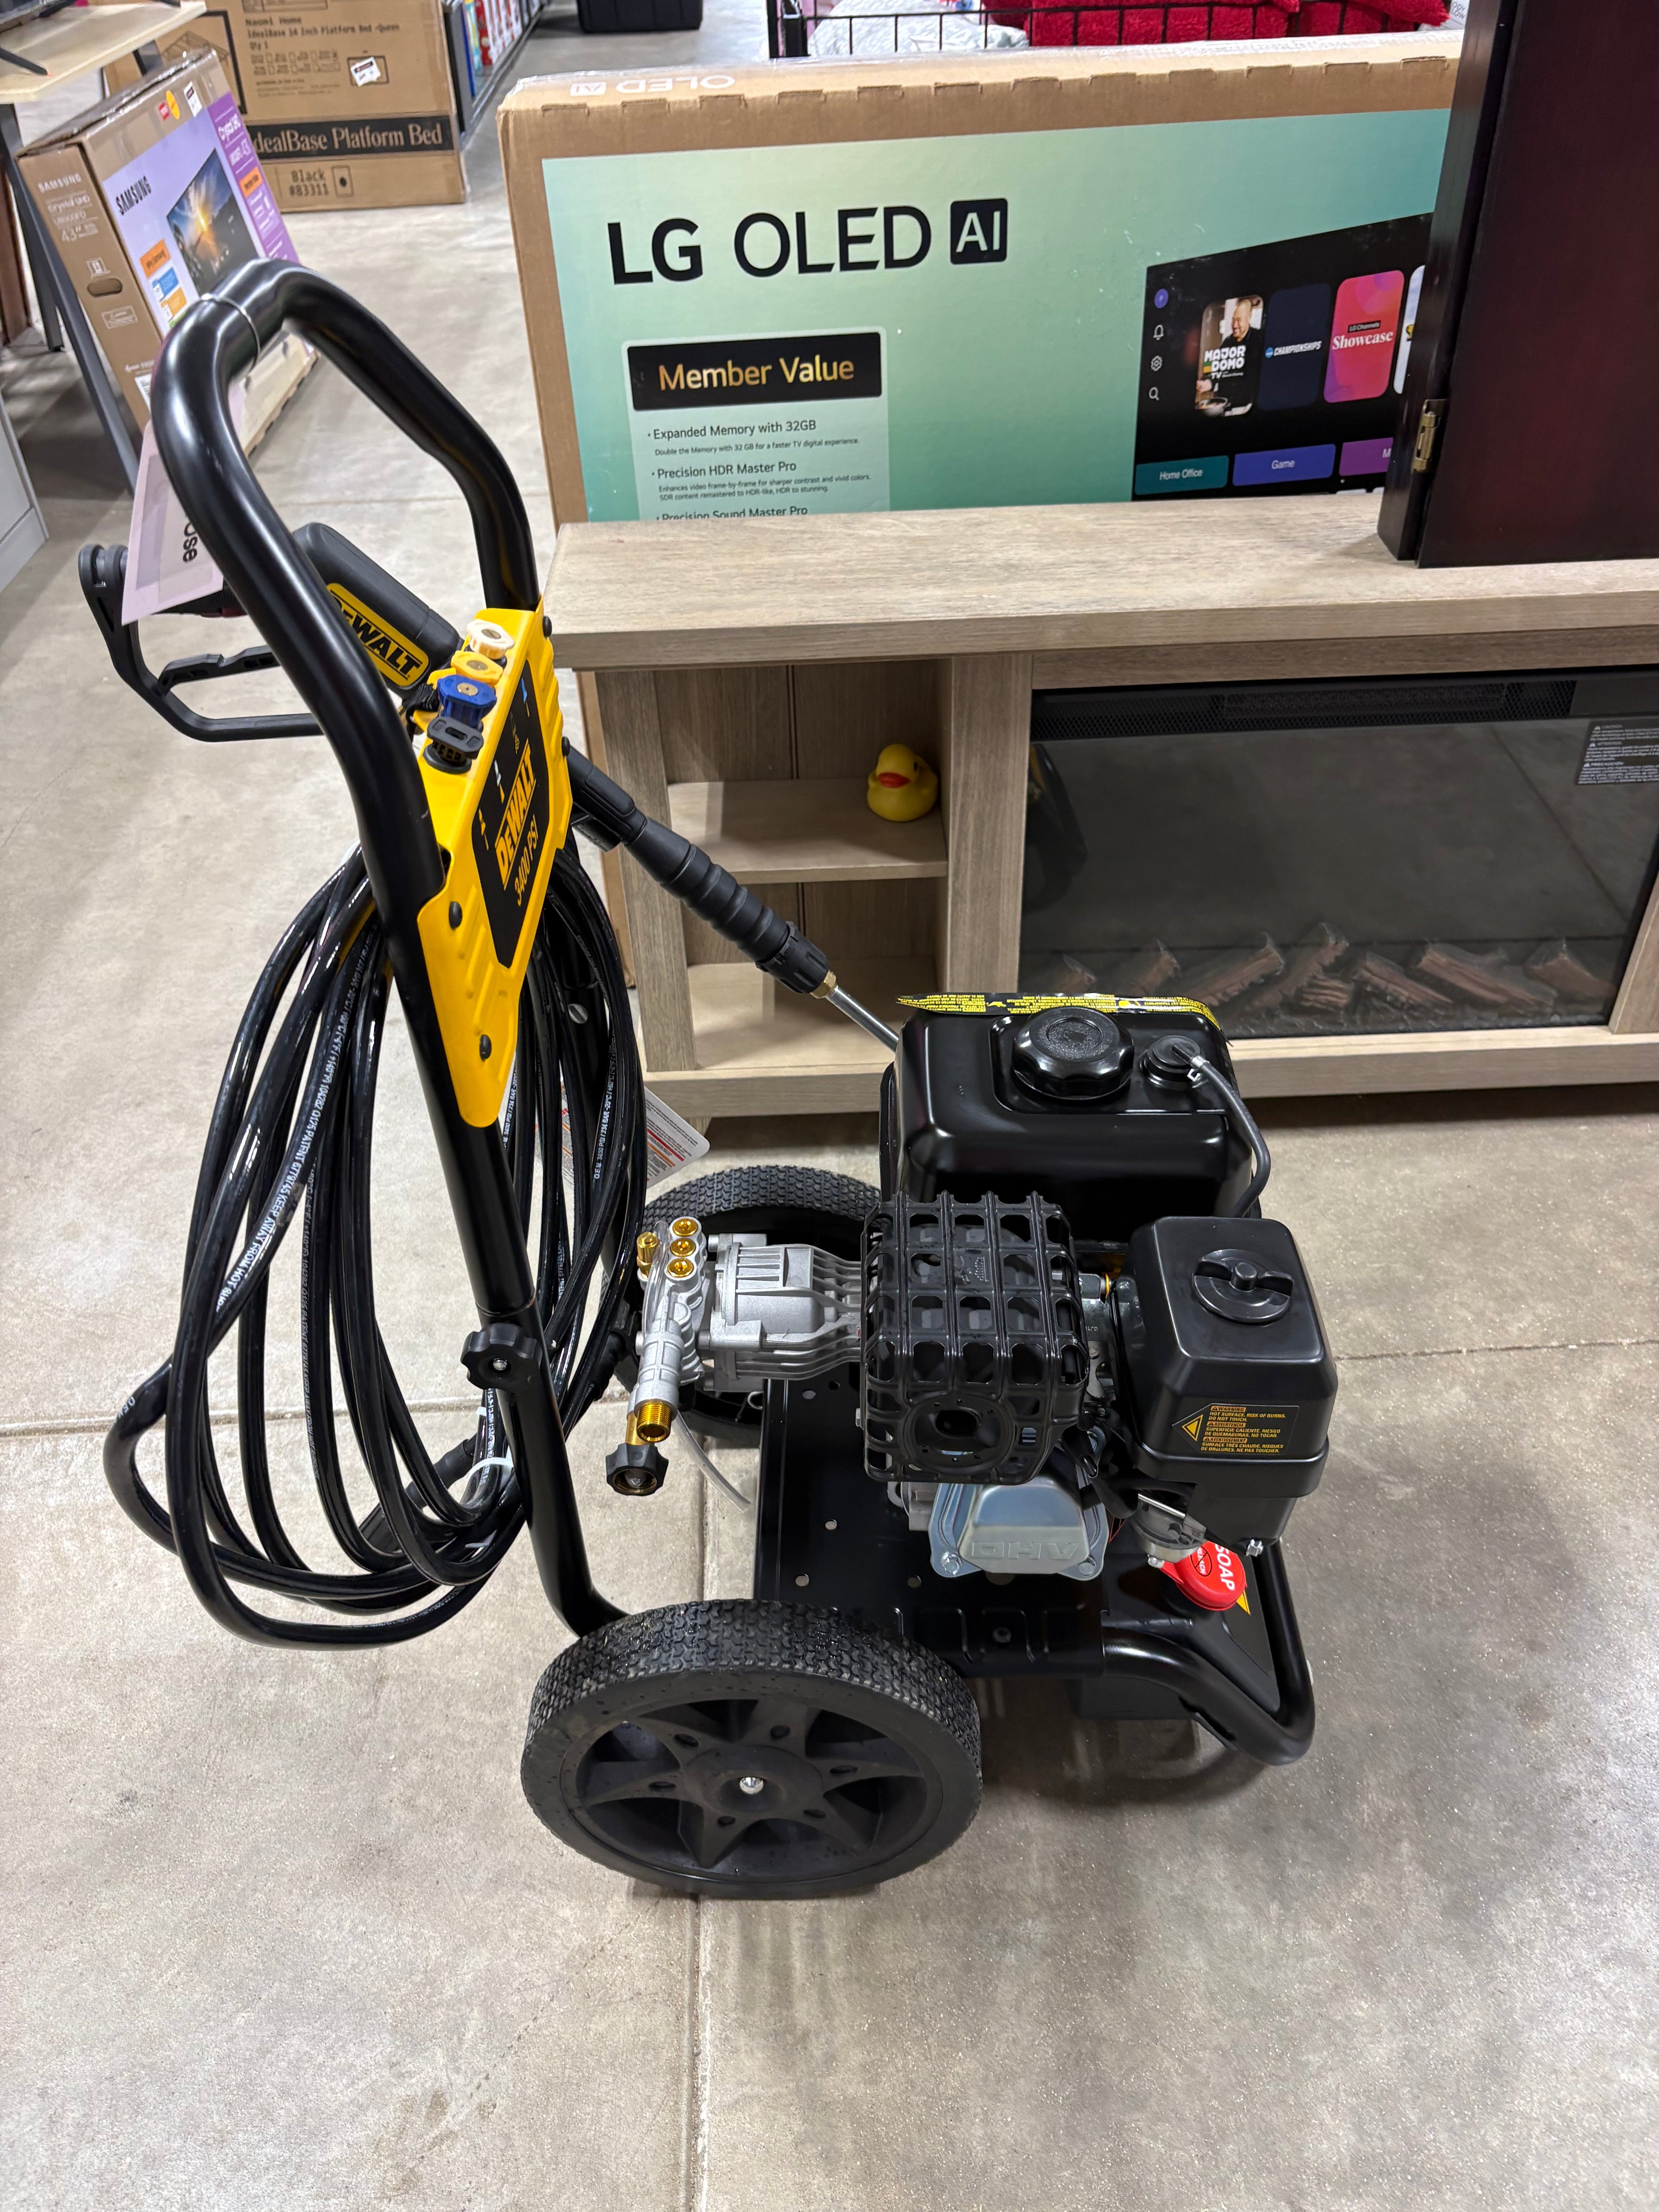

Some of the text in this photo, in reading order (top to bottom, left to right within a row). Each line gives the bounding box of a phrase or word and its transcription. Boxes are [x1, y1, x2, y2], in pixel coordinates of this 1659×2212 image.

[1452, 1, 1466, 11] ODY
[1452, 9, 1465, 19] LOW
[616, 75, 735, 94] OLED
[255, 129, 328, 153] dealBase
[332, 125, 404, 150] Platform
[407, 123, 443, 146] Bed
[38, 173, 82, 193] SAMSUNG
[291, 168, 325, 182] Black
[115, 175, 152, 215] SAMSUNG
[607, 205, 1003, 285] LG OLED AI
[1273, 340, 1322, 356] CHAMPIONSHIPS
[1332, 331, 1394, 350] Showcase
[1204, 345, 1246, 362] MAJOR
[658, 354, 855, 391] Member Value
[1211, 357, 1245, 372] DOMO
[1211, 371, 1222, 379] TV
[653, 420, 817, 442] Expanded Memory with 32GB
[772, 441, 791, 449] faster
[803, 439, 823, 448] digital
[824, 438, 860, 447] experience.
[657, 461, 797, 479] Precision HDR Master Pro
[1159, 468, 1203, 480] Home Office
[1271, 459, 1295, 470] Game
[707, 480, 756, 490] frame-by-frame
[769, 478, 793, 486] sharper
[700, 490, 736, 499] remastered
[661, 506, 808, 520] Precision Sound Master Pro
[334, 596, 421, 674] WALT
[495, 743, 535, 887] DEWALT
[515, 813, 539, 907] 3400 PSI
[314, 1084, 329, 1111] 104282
[294, 1128, 315, 1165] PATENT
[280, 1160, 302, 1195] 6779745
[269, 1192, 288, 1217] KEEP
[257, 1216, 276, 1244] AWAY
[240, 1241, 261, 1268] FROM
[227, 1267, 247, 1289] HOT
[972, 1541, 1080, 1560] OHV
[1214, 1543, 1236, 1592] SOAP
